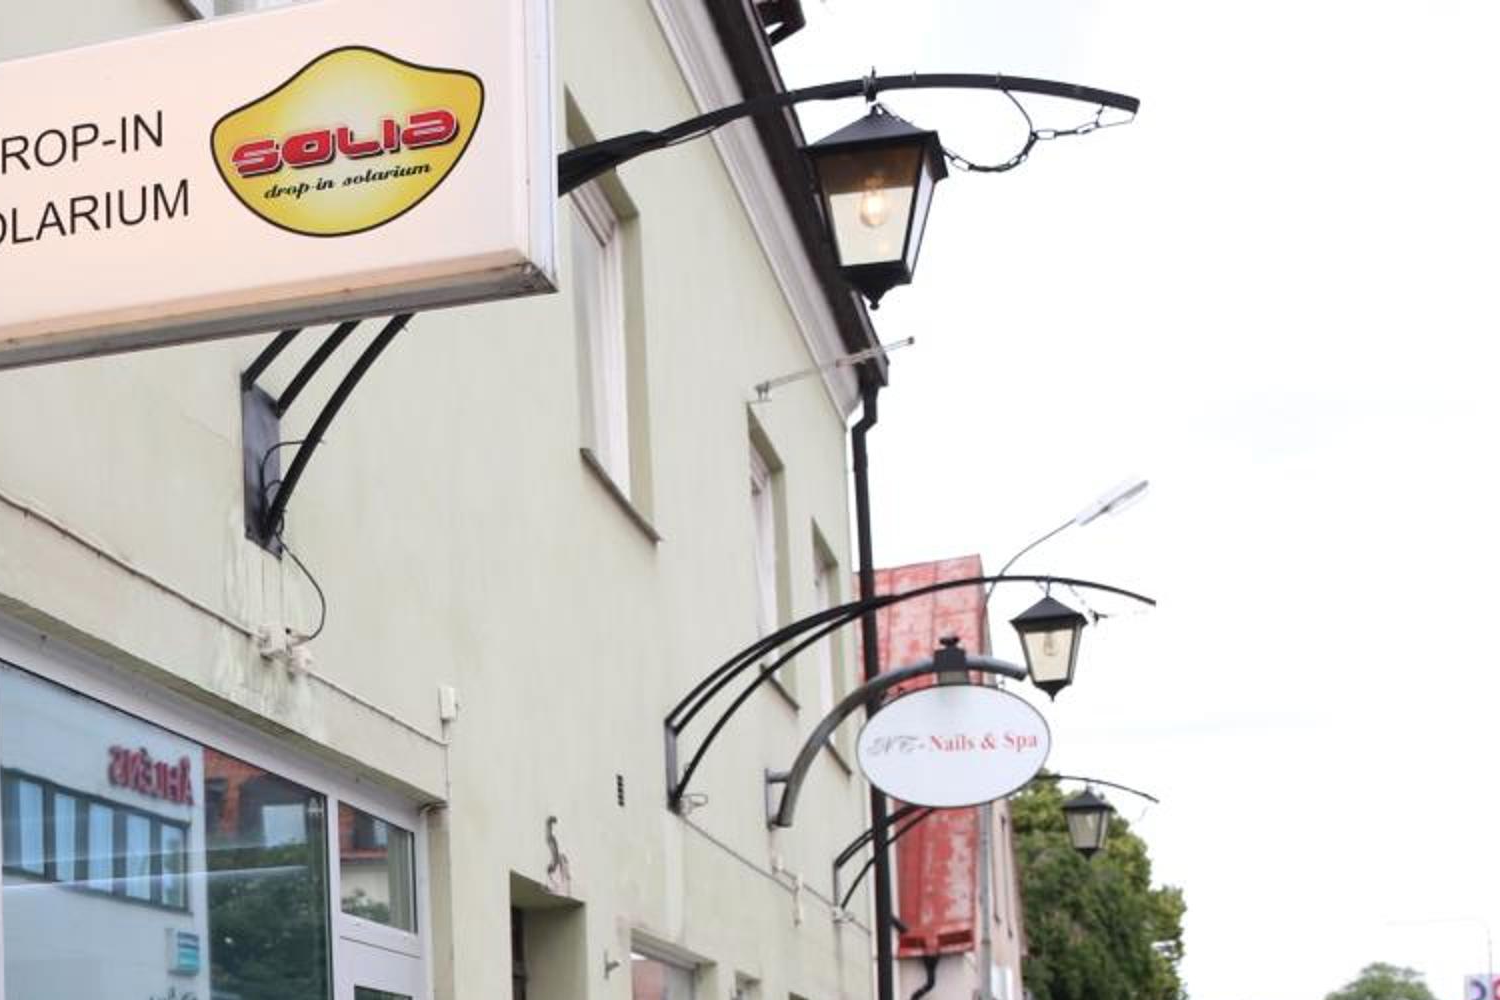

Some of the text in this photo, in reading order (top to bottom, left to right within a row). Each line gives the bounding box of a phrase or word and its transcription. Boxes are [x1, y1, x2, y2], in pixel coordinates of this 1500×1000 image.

[264, 162, 432, 200] drop-in solarium
[1002, 730, 1037, 754] Spa
